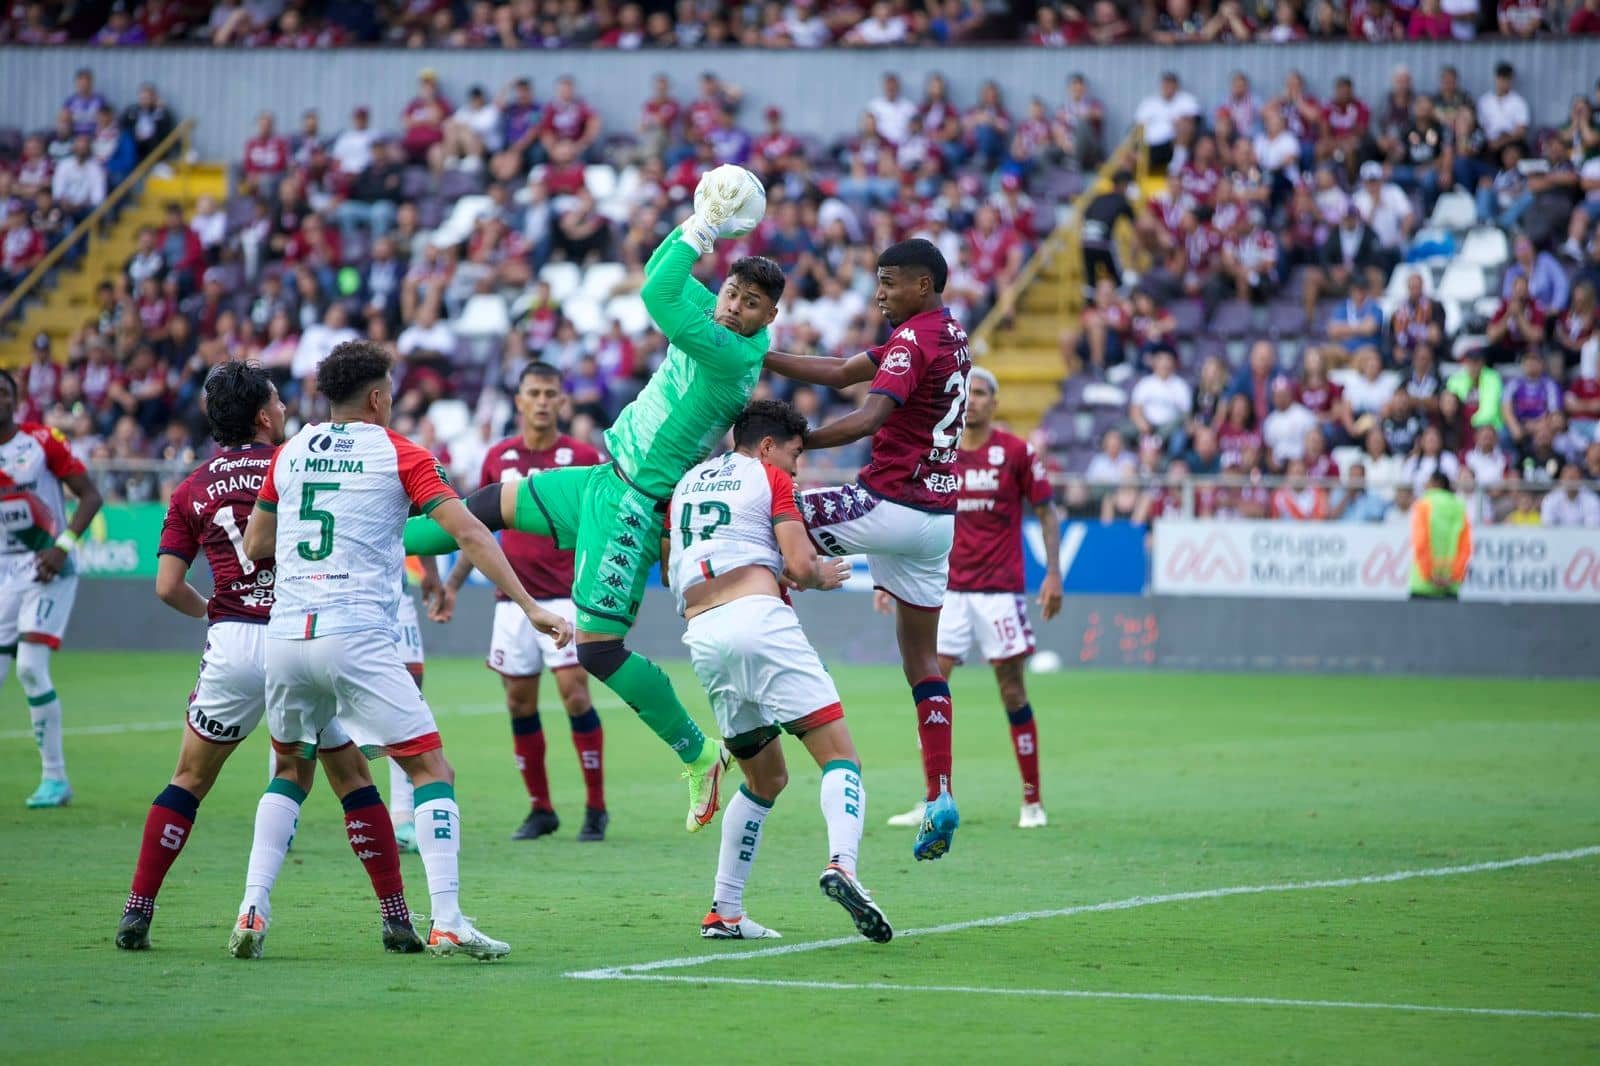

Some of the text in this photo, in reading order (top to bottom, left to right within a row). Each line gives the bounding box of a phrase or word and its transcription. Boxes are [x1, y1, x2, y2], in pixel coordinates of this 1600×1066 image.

[289, 458, 364, 473] Y. MOLINA
[192, 474, 267, 515] A. FRANC
[691, 480, 742, 493] OLIVERO
[297, 482, 342, 561] 5
[212, 505, 256, 575] 1
[1251, 531, 1346, 558] Grupo
[1471, 536, 1546, 564] rupo
[1252, 561, 1357, 586] Mutual
[993, 617, 1017, 641] 16
[160, 823, 185, 850] S
